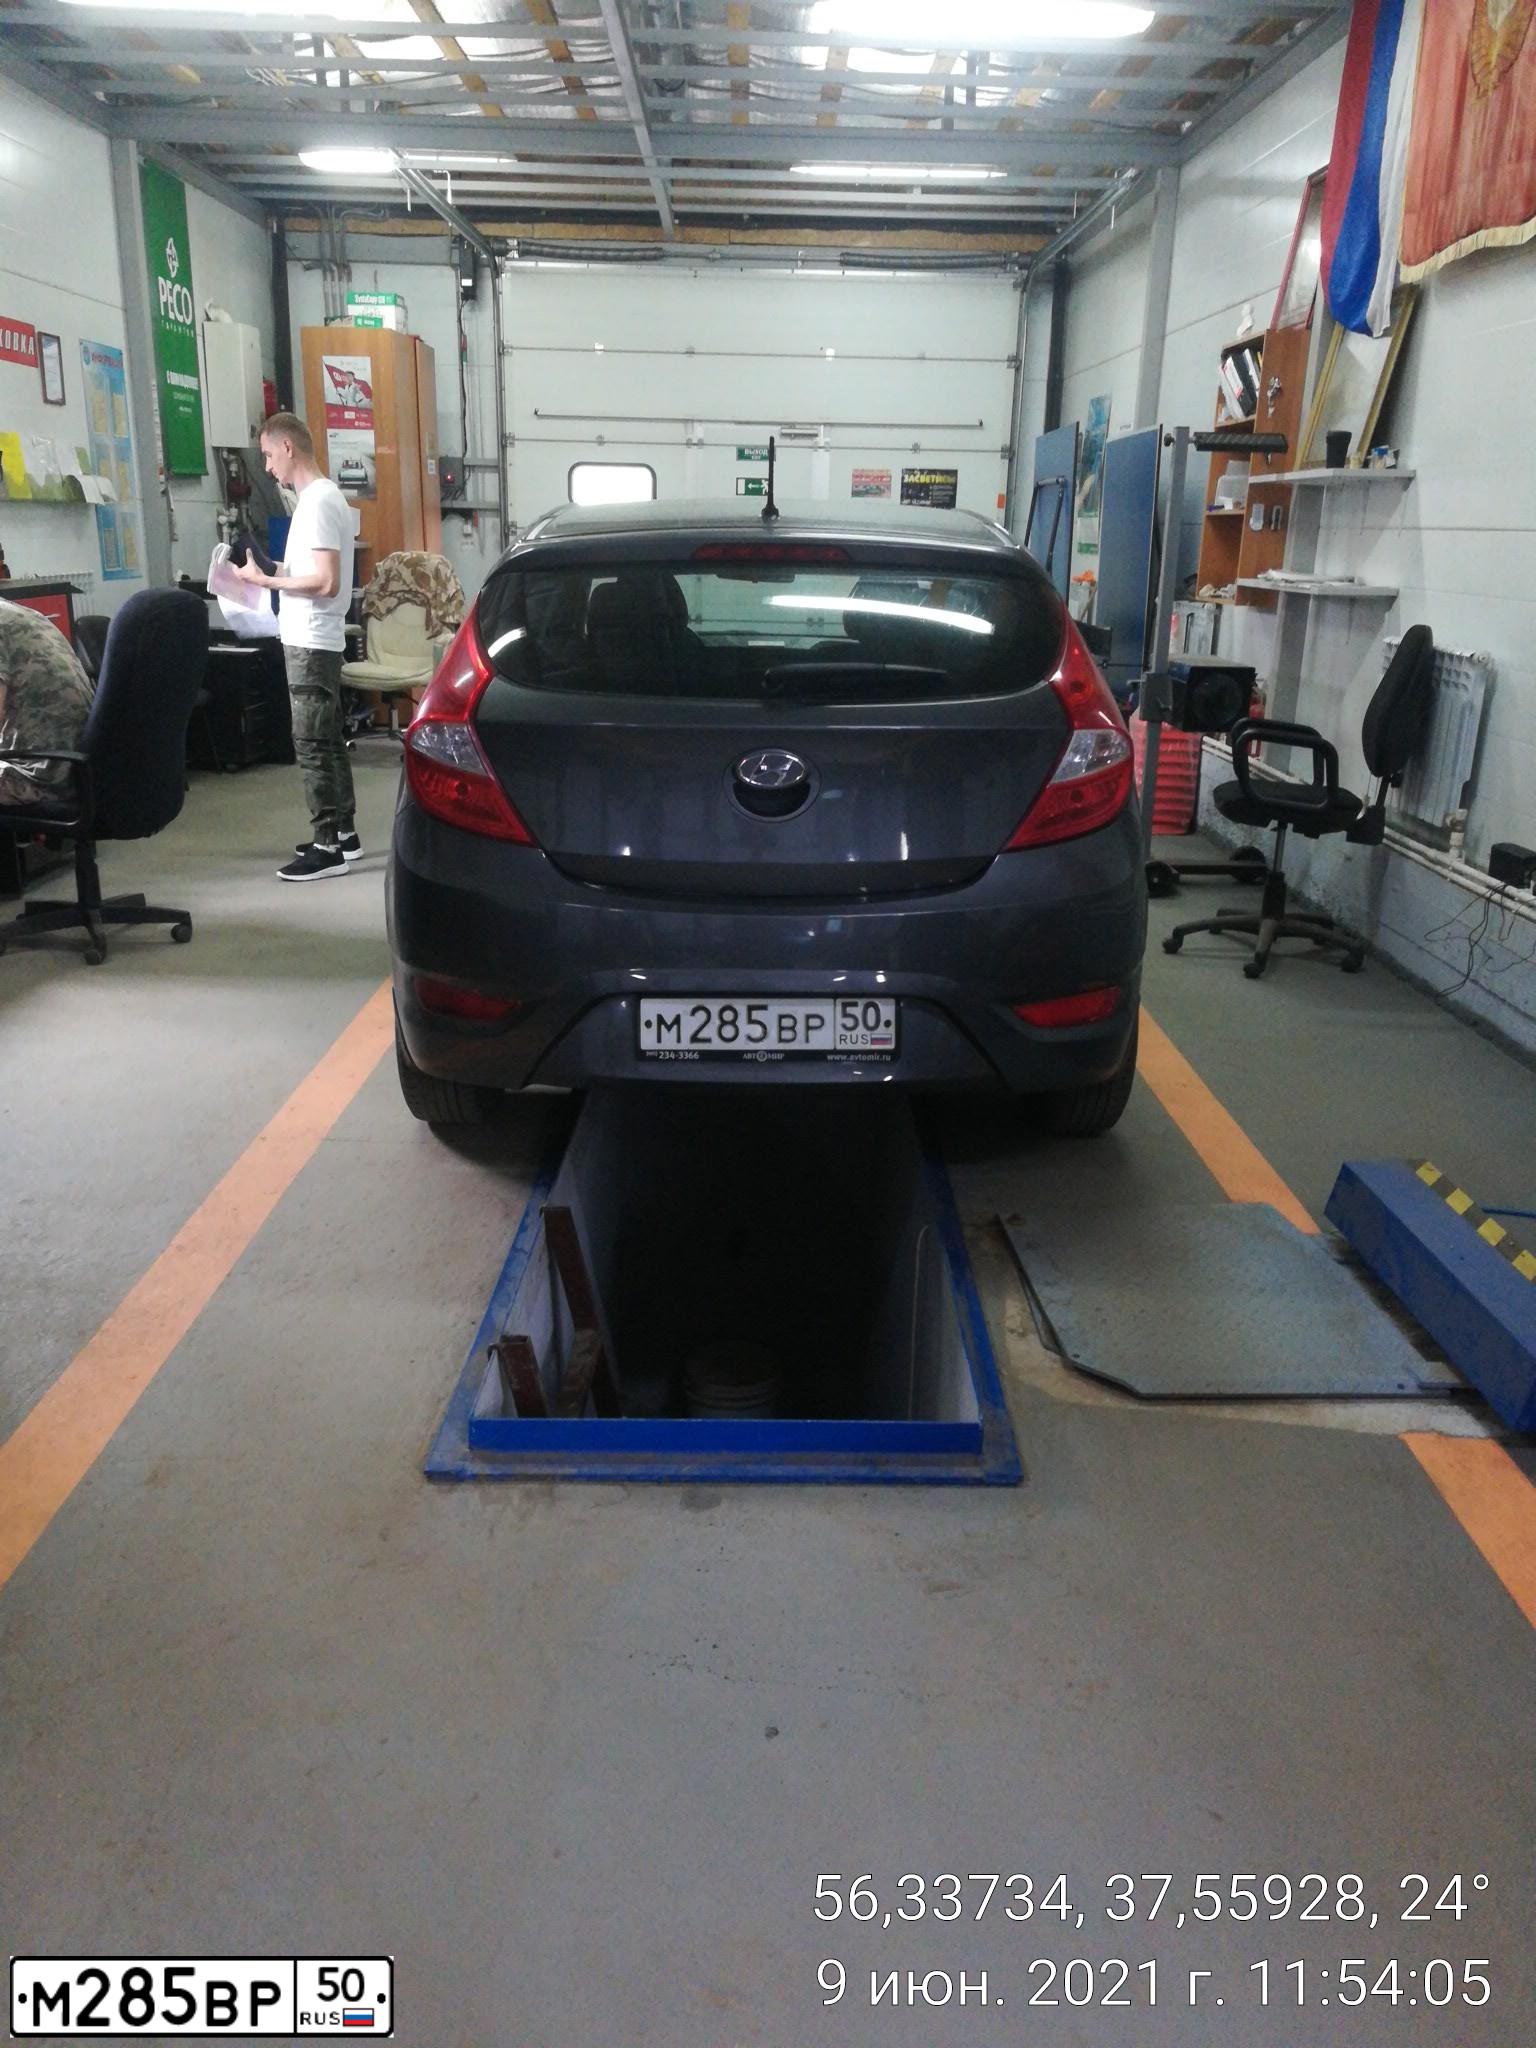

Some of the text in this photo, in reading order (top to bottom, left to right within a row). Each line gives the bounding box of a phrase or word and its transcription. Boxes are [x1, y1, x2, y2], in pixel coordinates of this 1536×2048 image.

[157, 275, 193, 326] РЕСО
[840, 1000, 882, 1032] 50
[838, 1033, 870, 1046] RUS
[658, 1050, 700, 1061] 234-3366
[826, 1052, 892, 1062] www.avtomir.ru
